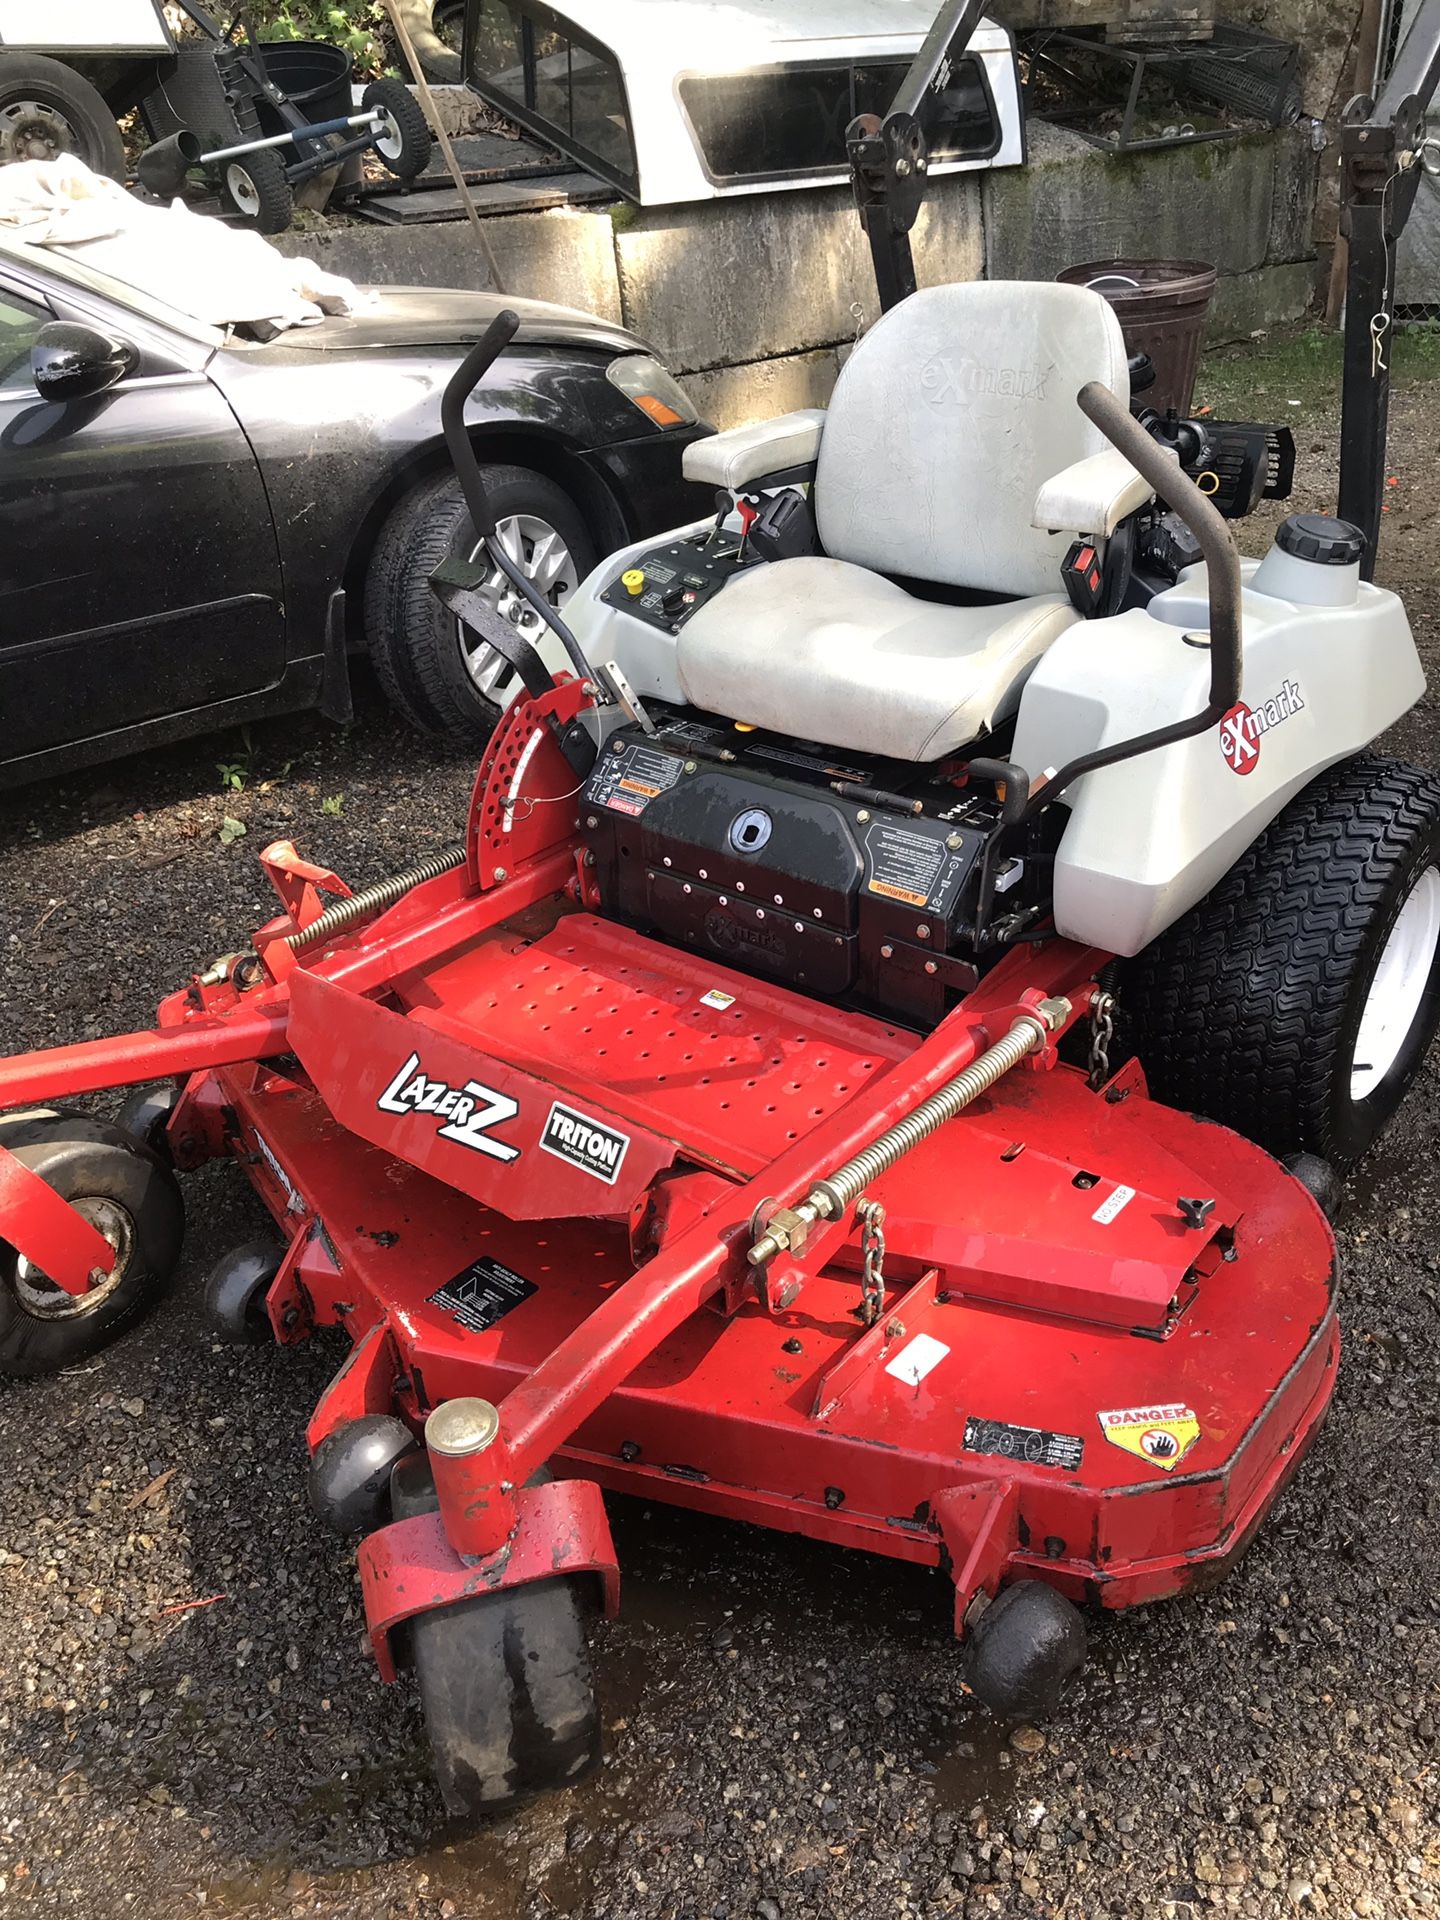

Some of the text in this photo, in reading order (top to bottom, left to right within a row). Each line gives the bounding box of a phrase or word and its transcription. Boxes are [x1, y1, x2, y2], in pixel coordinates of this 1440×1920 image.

[1220, 679, 1304, 771] eXmark
[876, 883, 910, 900] WARNING
[377, 1050, 521, 1163] LAZER Z
[550, 1111, 621, 1166] TRITON
[1097, 1188, 1127, 1221] NO STEP
[1107, 1408, 1188, 1424] DANGER
